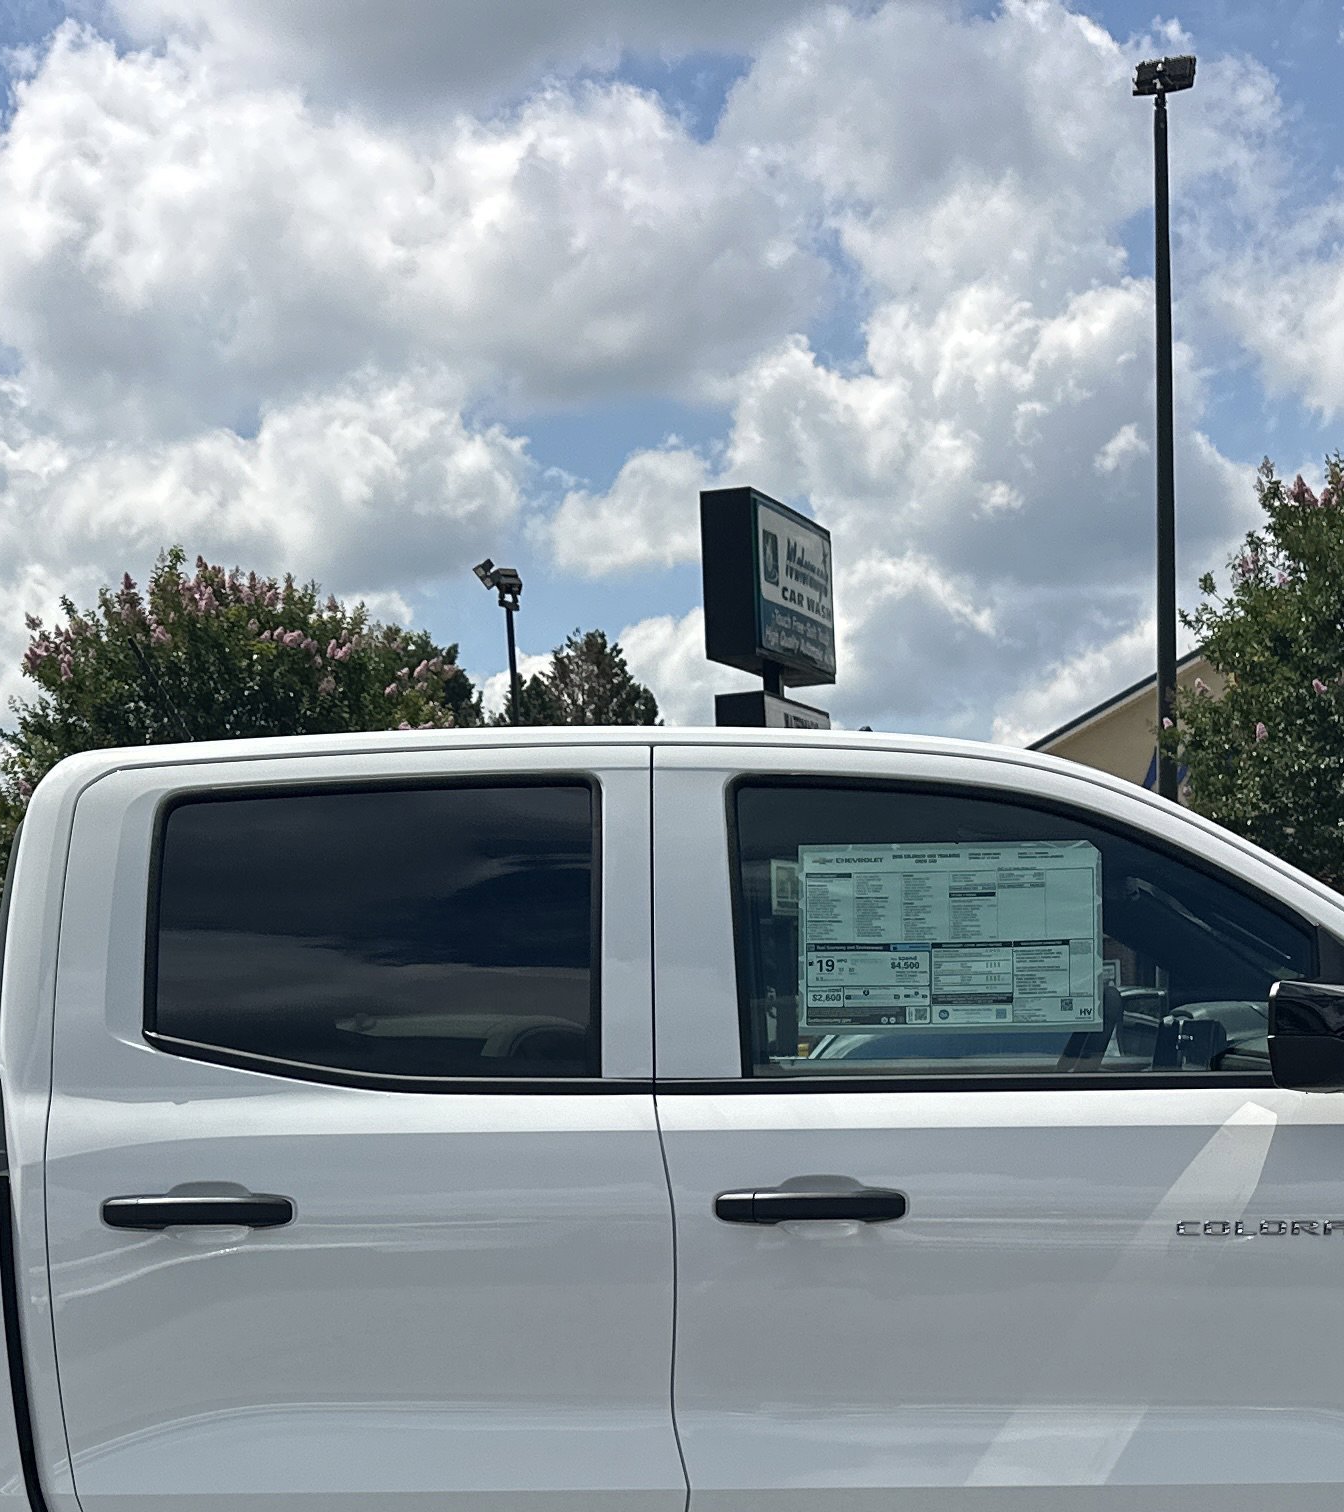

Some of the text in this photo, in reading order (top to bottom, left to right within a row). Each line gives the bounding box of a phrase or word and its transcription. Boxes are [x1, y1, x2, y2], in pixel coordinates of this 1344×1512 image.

[781, 586, 832, 621] CAR WASH
[816, 959, 835, 973] 19
[890, 961, 920, 970] $4,500
